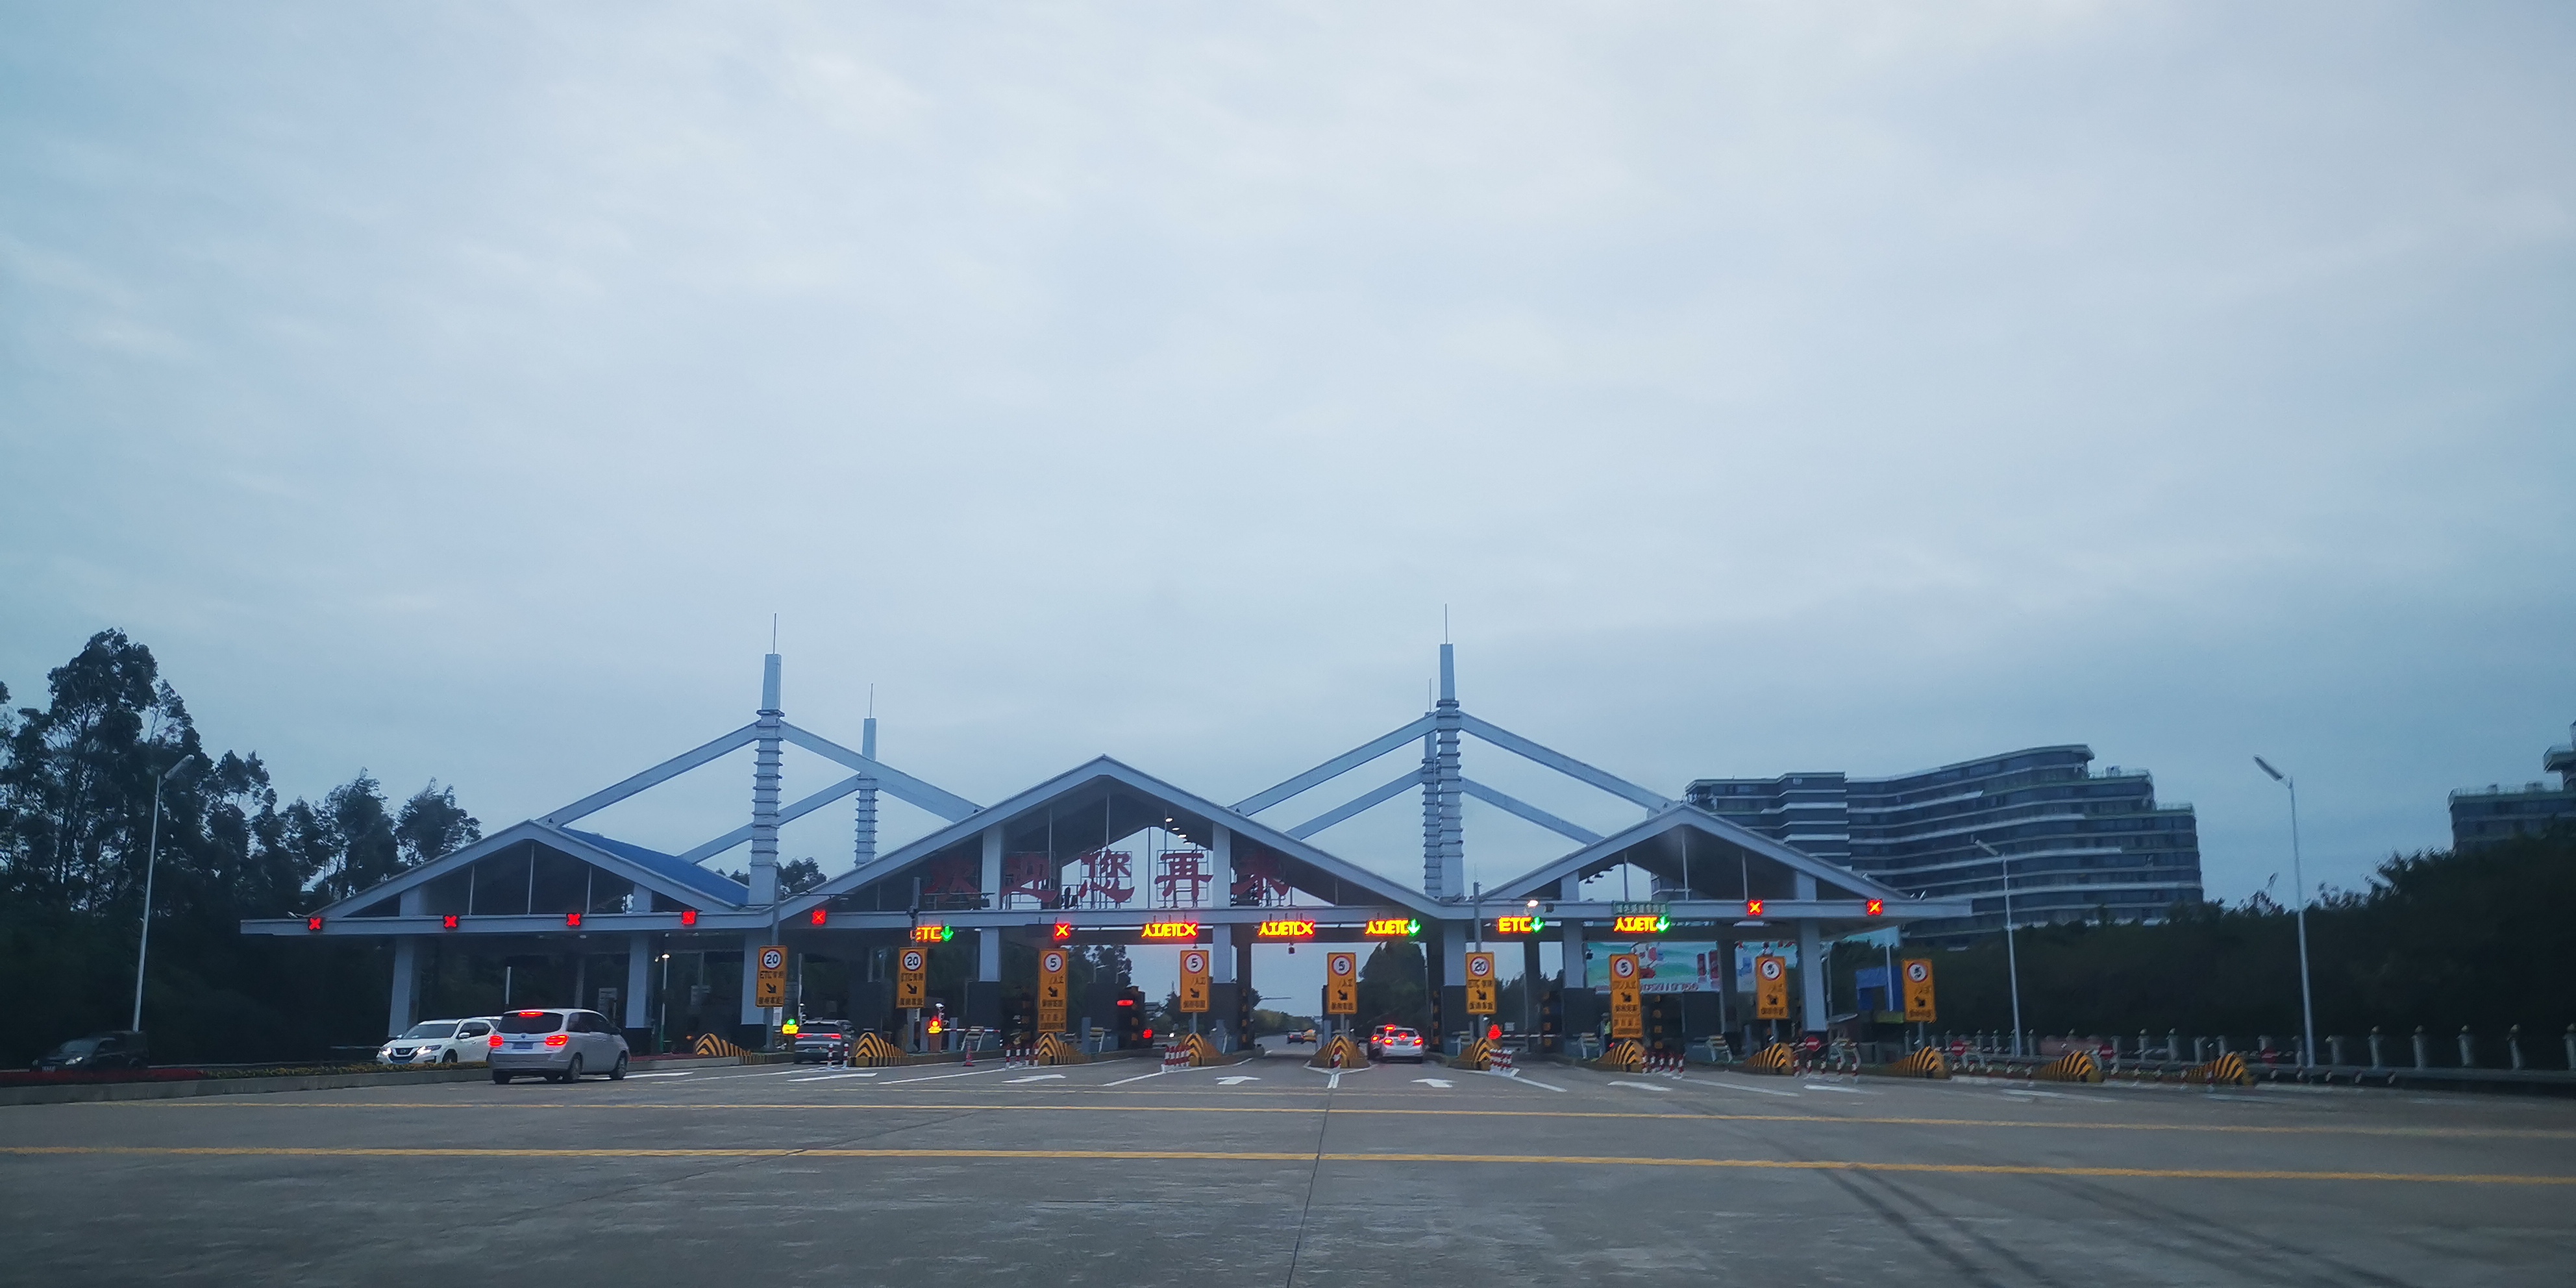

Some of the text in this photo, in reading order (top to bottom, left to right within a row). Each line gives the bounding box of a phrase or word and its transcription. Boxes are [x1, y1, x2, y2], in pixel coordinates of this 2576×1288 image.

[1498, 917, 1532, 932] ETC
[766, 954, 778, 964] 20
[907, 956, 919, 966] 20
[1473, 961, 1487, 972] 20
